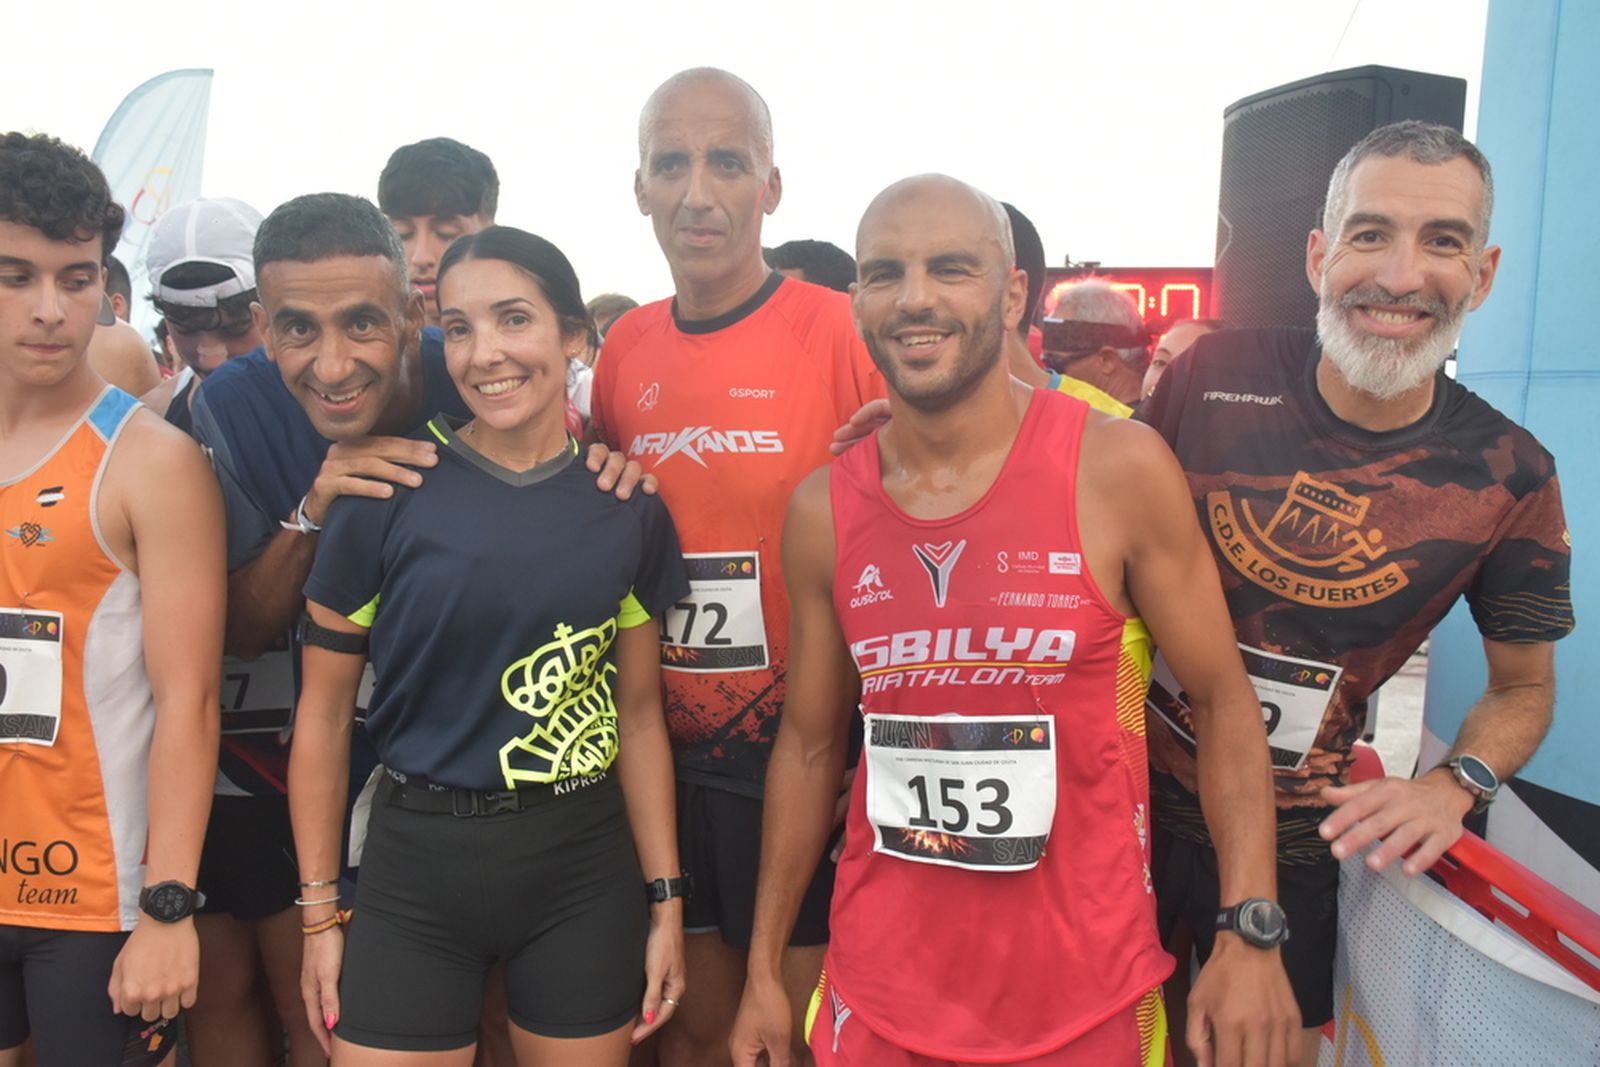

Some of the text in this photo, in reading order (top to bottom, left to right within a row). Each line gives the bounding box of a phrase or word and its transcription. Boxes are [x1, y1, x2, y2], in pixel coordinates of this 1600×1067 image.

[729, 388, 775, 399] GSPORT
[1018, 551, 1039, 560] IMD
[1247, 559, 1290, 590] LOS
[1294, 572, 1399, 601] FUERTES
[997, 592, 1080, 609] FERNANDO TORRES
[850, 627, 1076, 672] SBILYA
[861, 667, 1026, 695] RIATHLON
[907, 775, 1014, 835] 153
[17, 879, 79, 904] team
